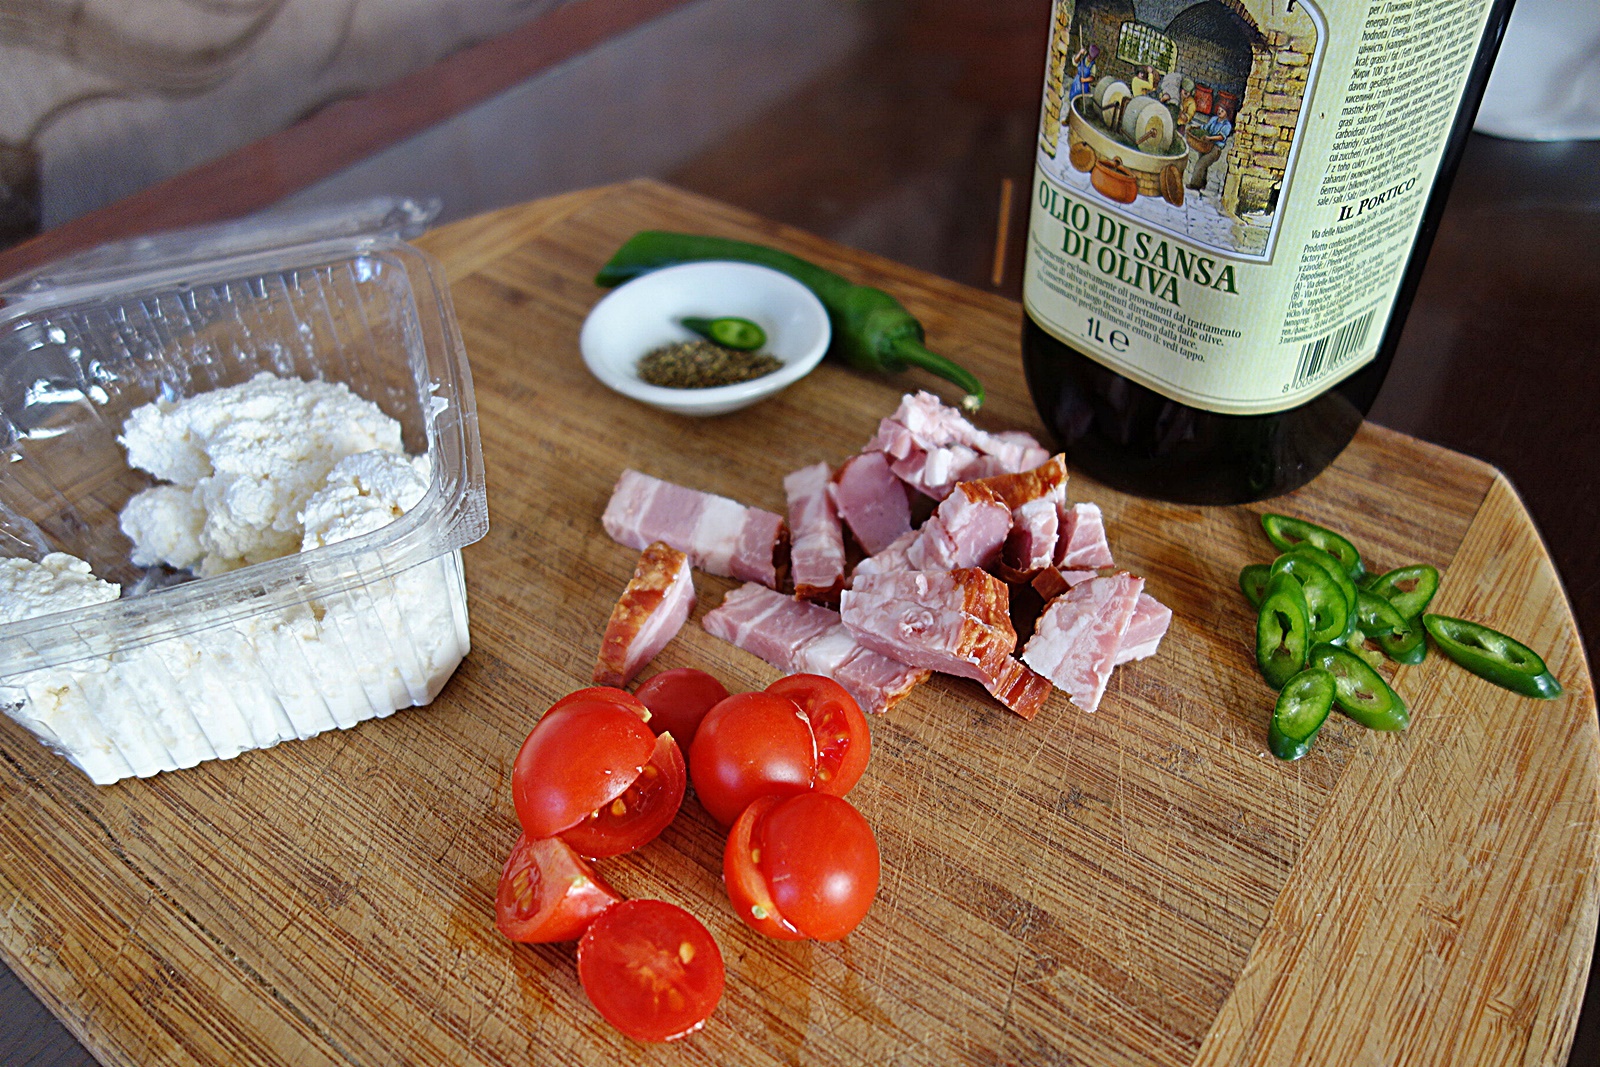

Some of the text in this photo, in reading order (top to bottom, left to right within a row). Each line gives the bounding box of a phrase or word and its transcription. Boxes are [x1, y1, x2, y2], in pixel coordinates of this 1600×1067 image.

[1365, 16, 1389, 29] energia
[1368, 6, 1381, 17] per
[1362, 30, 1387, 41] hodnota
[1348, 81, 1367, 91] davon
[1317, 197, 1329, 206] sale
[1039, 180, 1090, 232] OLIO
[1094, 213, 1130, 254] DI
[1133, 231, 1239, 295] SANSA
[1061, 226, 1094, 265] DI
[1097, 246, 1181, 307] OLIVA
[1066, 260, 1242, 339] esclusivamente oli provenienti dal trattamento
[1088, 282, 1098, 294] oli
[1098, 289, 1127, 308] ottenuti
[1128, 301, 1176, 330] direttamente
[1177, 324, 1198, 339] dalle
[1198, 332, 1224, 347] olive.
[1078, 299, 1130, 330] preferibilmente
[1131, 326, 1152, 340] entro
[1153, 334, 1161, 345] il:
[1162, 339, 1178, 353] vedi
[1179, 345, 1205, 363] tappo.
[1084, 289, 1102, 305] luogo
[1102, 299, 1125, 317] fresco,
[1126, 312, 1134, 321] al
[1134, 315, 1158, 332] riparo
[1158, 326, 1177, 341] dalla
[1178, 333, 1198, 350] luce.
[1282, 383, 1290, 393] 8
